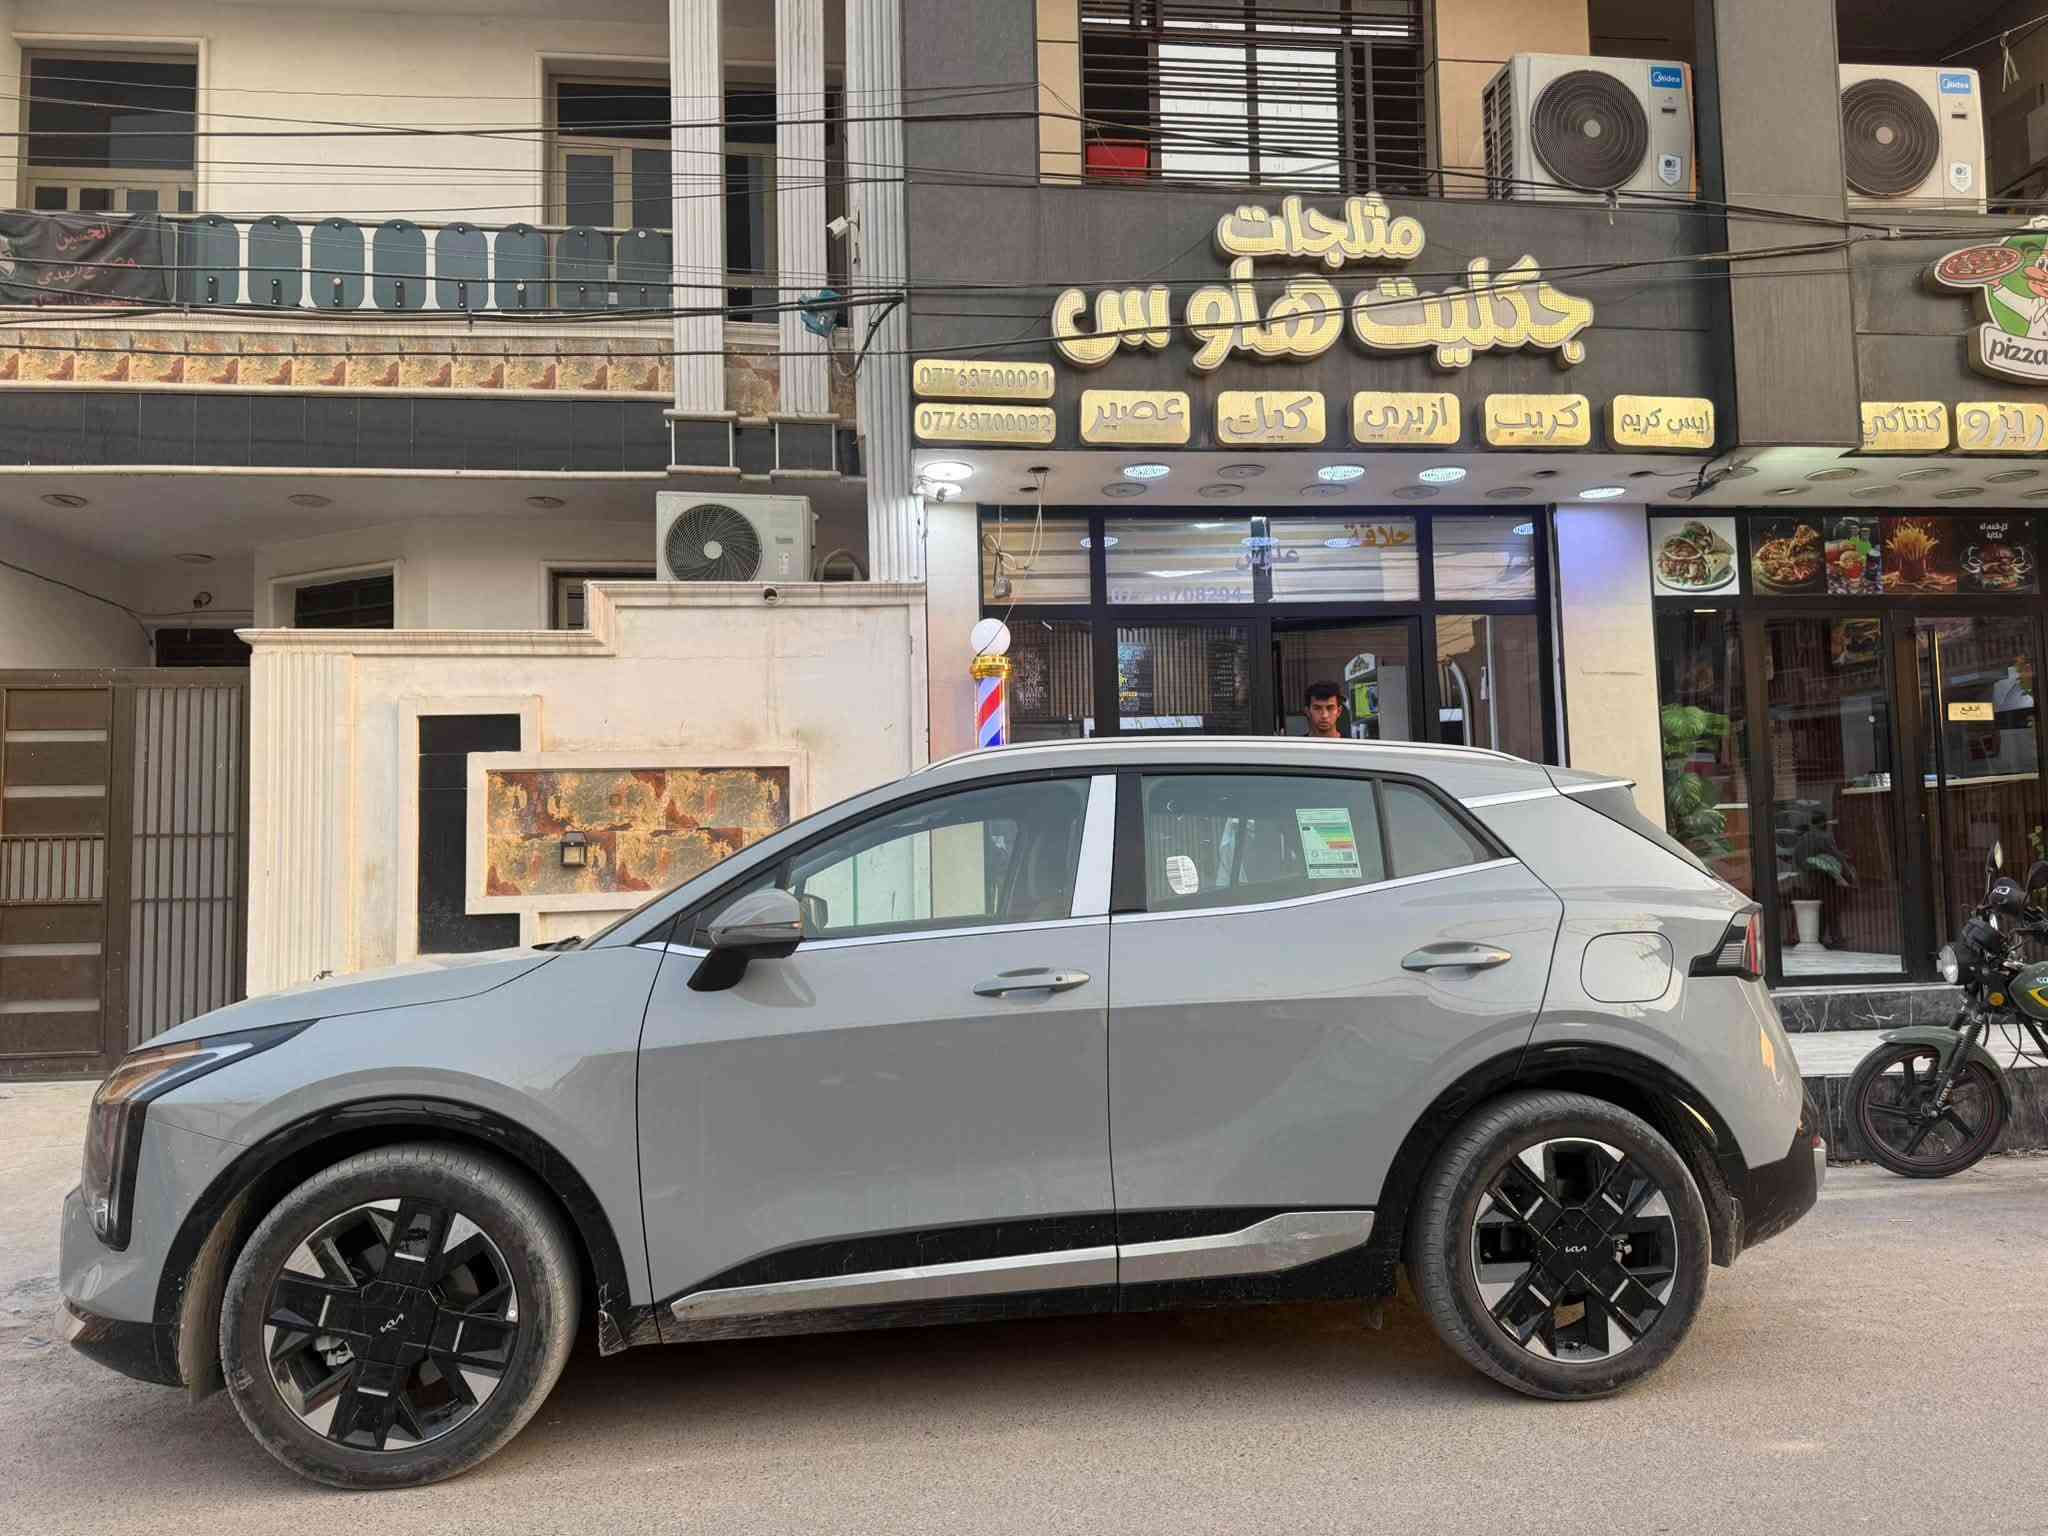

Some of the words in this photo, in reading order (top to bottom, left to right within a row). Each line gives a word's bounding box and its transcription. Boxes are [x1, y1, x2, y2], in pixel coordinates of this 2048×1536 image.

[1219, 193, 1426, 268] مثلجات
[1053, 257, 1343, 370] هاوس
[1353, 254, 1593, 367] جكليت
[1086, 398, 1184, 435] عصير
[1222, 396, 1314, 441] كيك
[1493, 400, 1582, 439] كريب
[1621, 408, 1662, 434] كريم
[1667, 411, 1710, 436] ايس
[1964, 405, 2045, 449] ريزو
[1343, 523, 1410, 546] حلاقة
